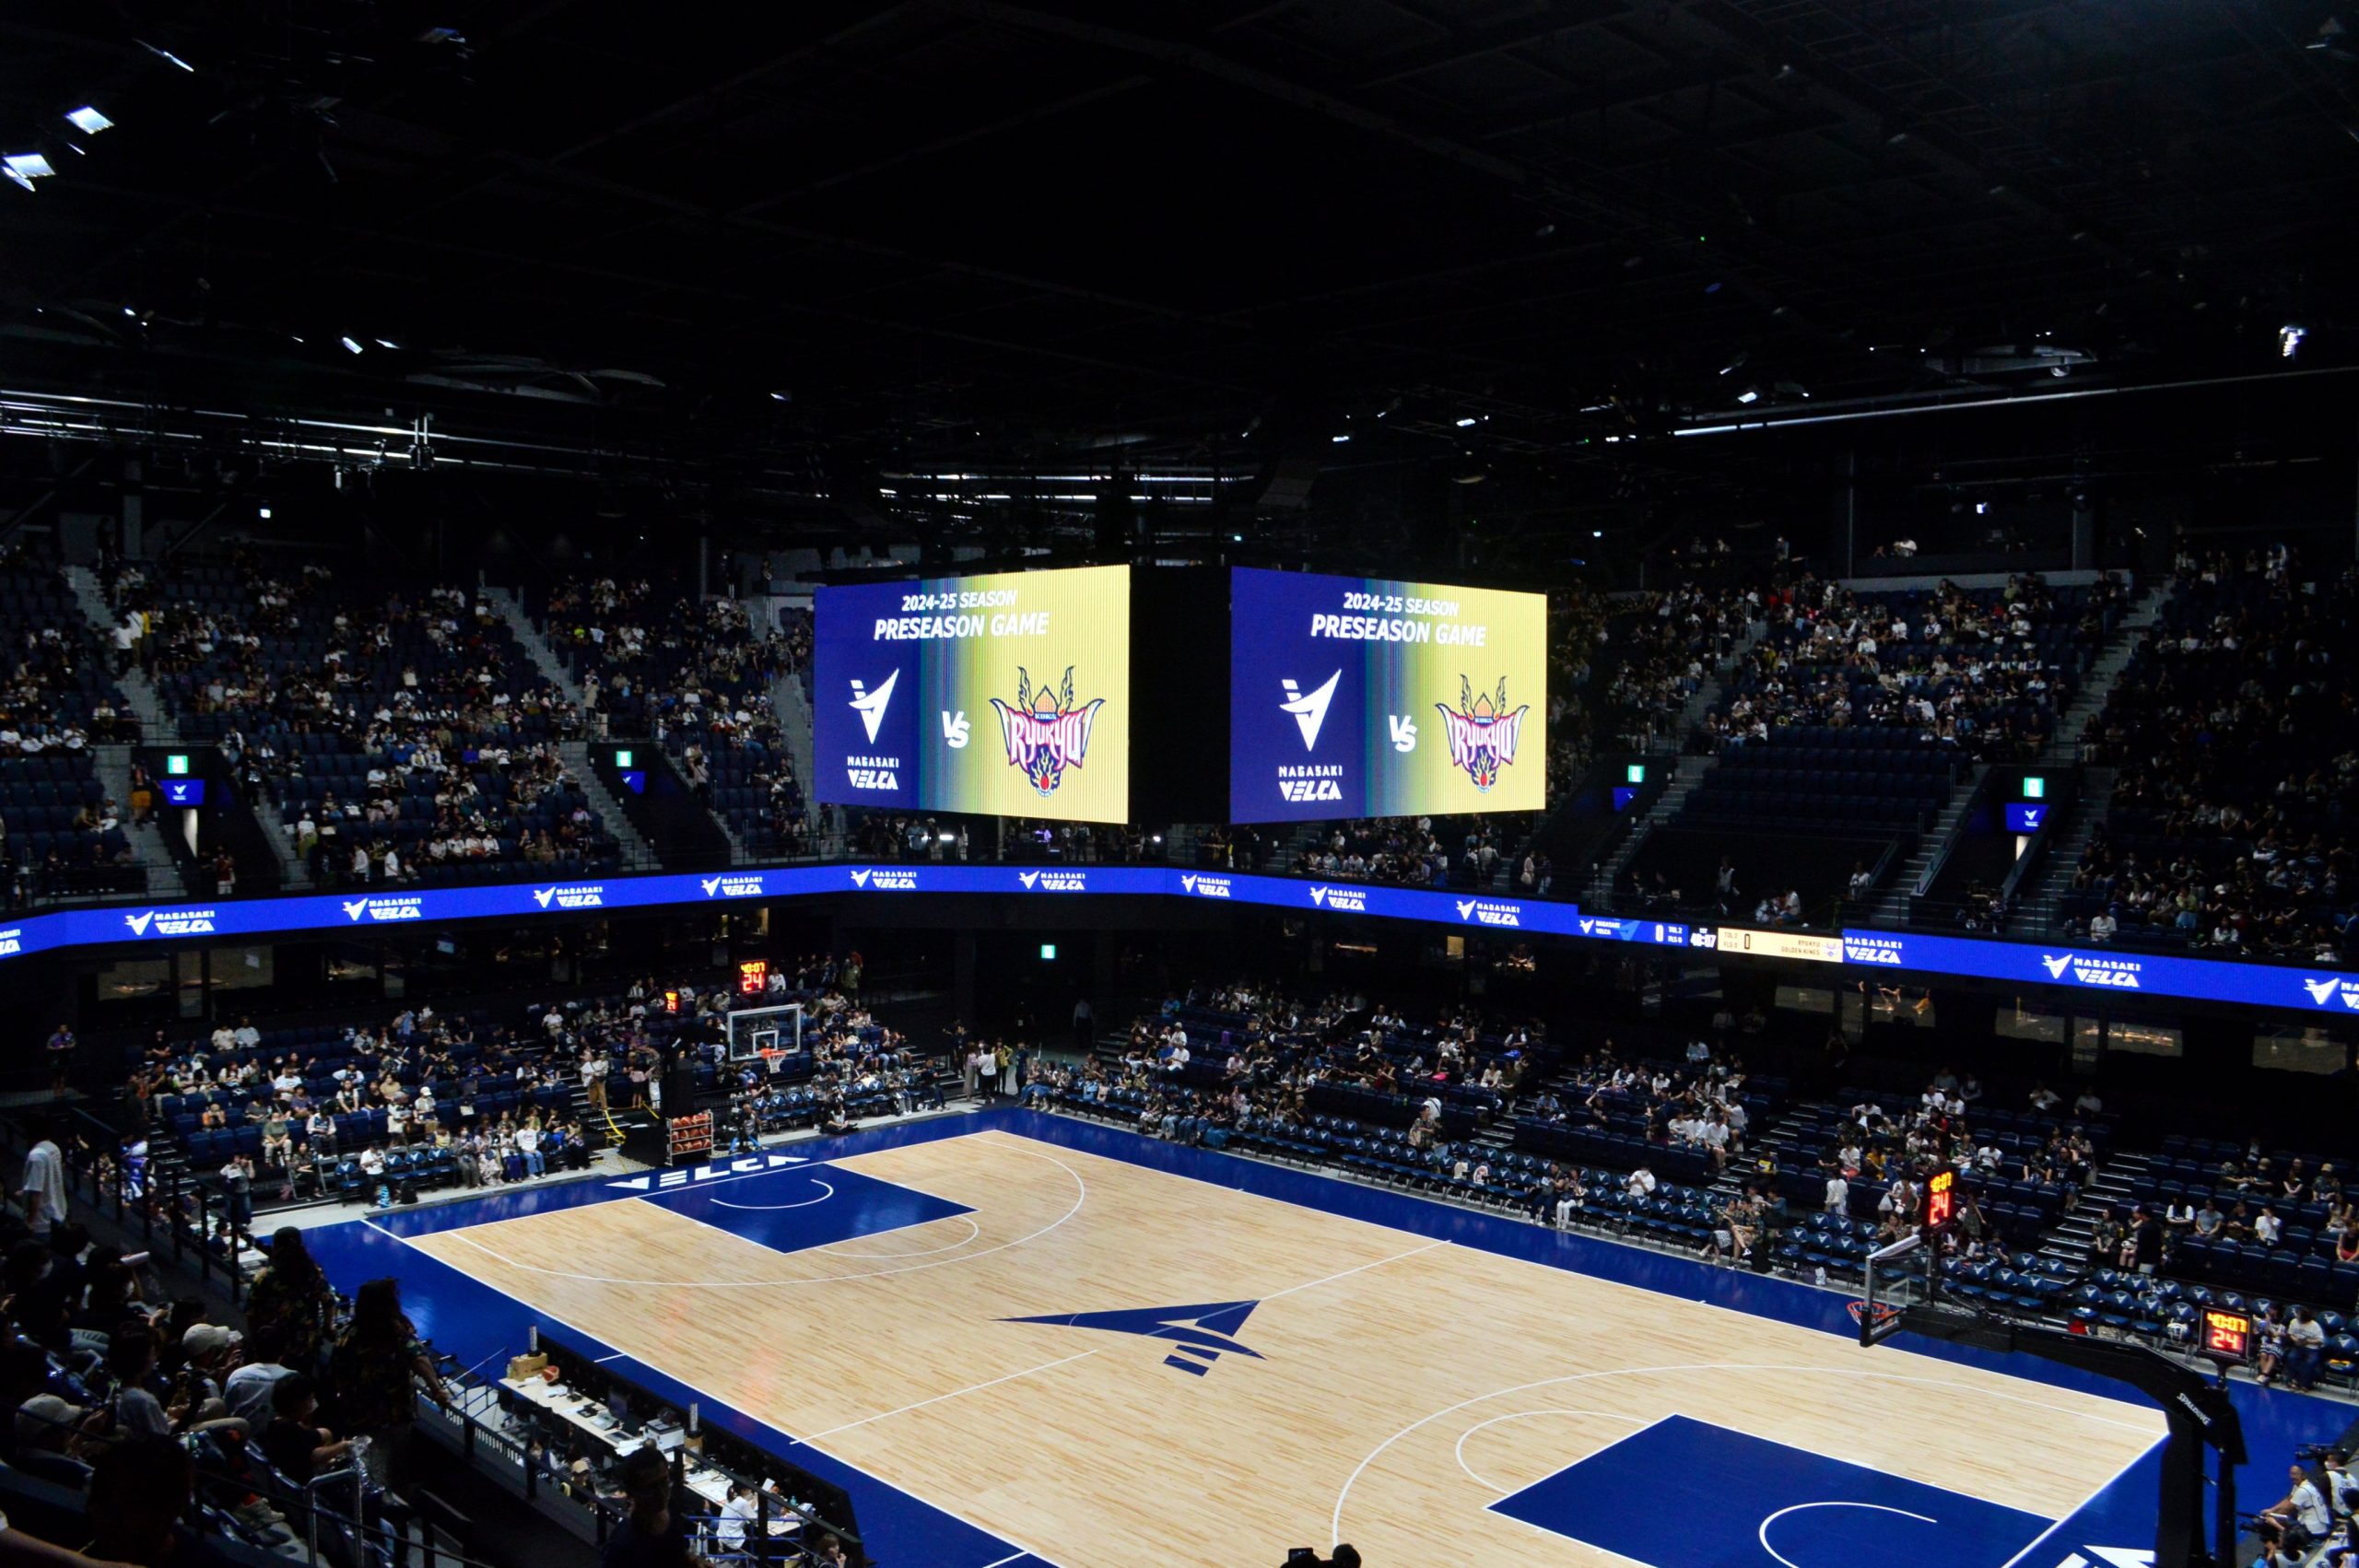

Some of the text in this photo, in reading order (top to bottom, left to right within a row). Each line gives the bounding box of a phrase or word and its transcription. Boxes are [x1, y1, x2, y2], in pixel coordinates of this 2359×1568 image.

[901, 590, 1017, 612] 2024-25 SEASON
[1344, 591, 1460, 616] 2024-25 SEASON
[874, 612, 1050, 640] PRESEASON GAME
[1310, 614, 1487, 647] PRESEASON GAME
[942, 710, 970, 748] VS
[1389, 714, 1418, 753] VS
[1007, 707, 1086, 773] RYUKYU
[1451, 712, 1516, 773] RYUKYU
[847, 755, 899, 768] NAGASAKI
[847, 769, 898, 790] VELCA
[1278, 765, 1343, 778] NAGASAKI
[1278, 780, 1343, 802] VELCA
[557, 886, 603, 895] NAGASAKI
[722, 884, 762, 895] VELCA
[873, 878, 917, 889] VELCA
[1041, 879, 1086, 890] VELCA
[1198, 884, 1230, 897] VELCA
[369, 897, 421, 907] NAGASAKI
[557, 895, 603, 907] VELCA
[1328, 896, 1366, 910] VELCA
[1476, 903, 1520, 913] NAGASAKI
[155, 911, 215, 920] NAGASAKI
[370, 907, 421, 919] VELCA
[1477, 911, 1520, 927] VELCA
[156, 920, 215, 934] VELCA
[1743, 933, 1751, 950] 0
[1845, 937, 1903, 950] NAGASAKI
[1845, 946, 1902, 965] VELCA
[2074, 957, 2142, 971] NAGASAKI
[740, 961, 766, 974] 40:07
[743, 973, 764, 992] 24
[2074, 968, 2140, 988] VELCA
[604, 1155, 810, 1189] VELCA
[1930, 1191, 1950, 1224] 24
[2206, 1311, 2248, 1333] 40:07
[2212, 1328, 2239, 1350] 24
[2176, 1392, 2212, 1426] SPALDING
